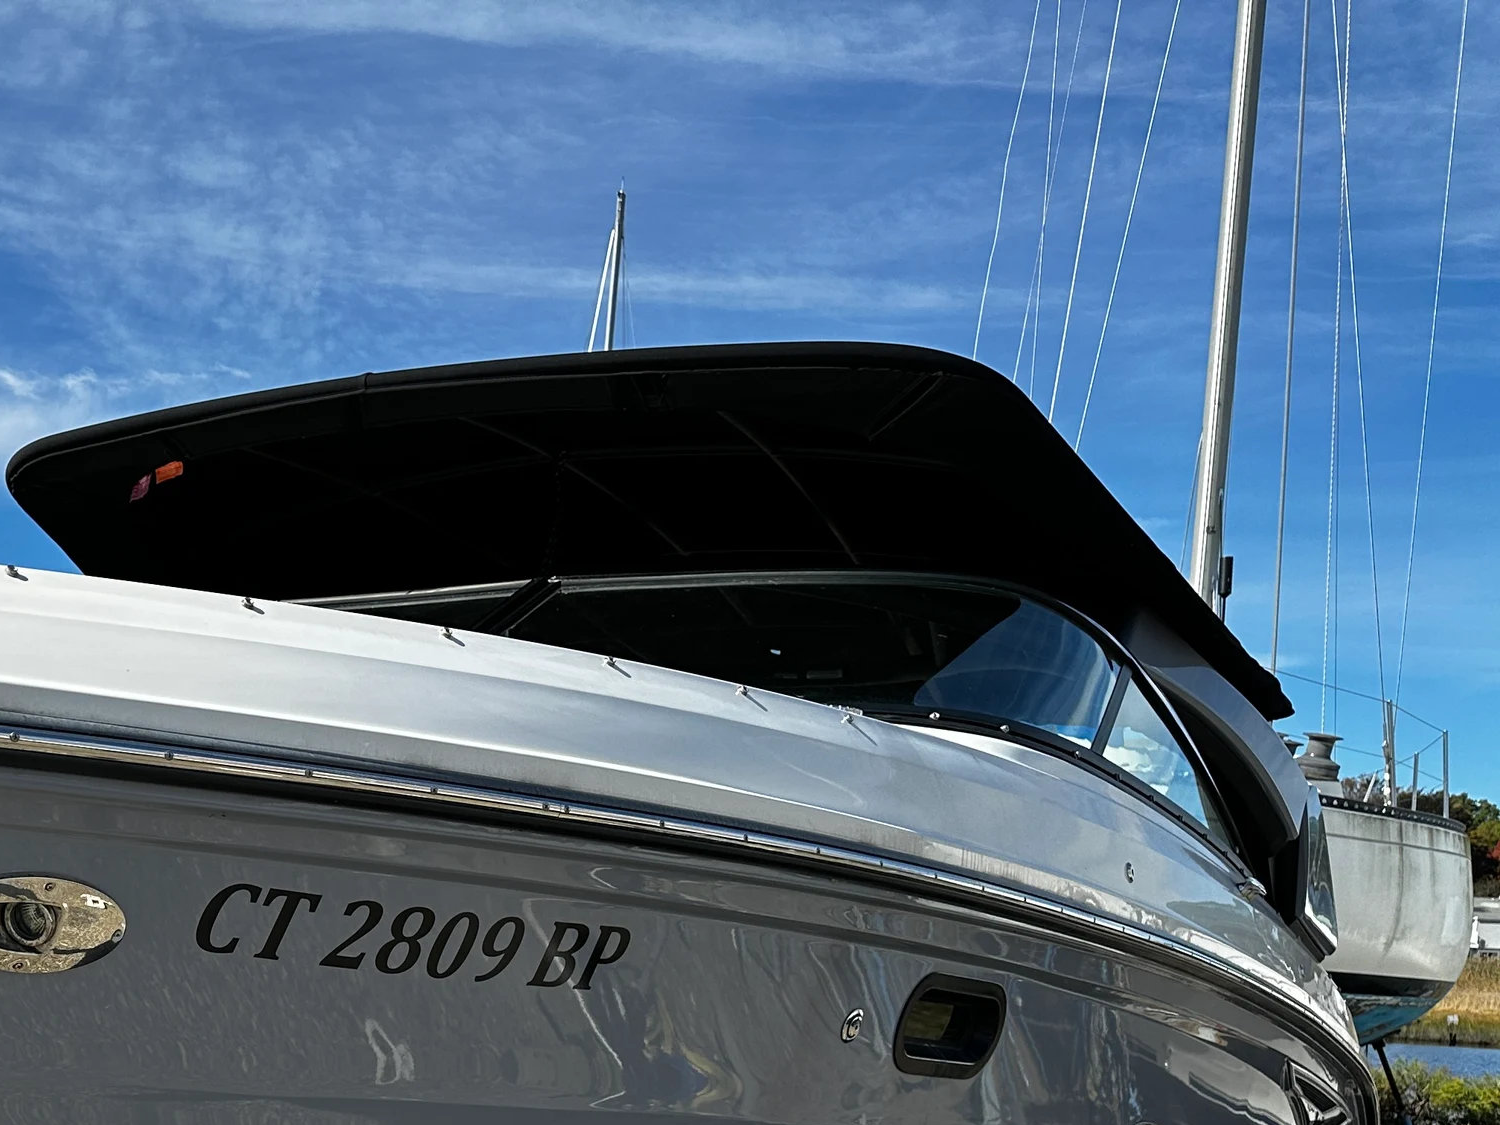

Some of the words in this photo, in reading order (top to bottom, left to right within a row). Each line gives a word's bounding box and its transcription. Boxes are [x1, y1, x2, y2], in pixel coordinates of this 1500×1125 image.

[195, 883, 323, 960] CT
[319, 900, 526, 983] 2809
[526, 920, 631, 991] BP
